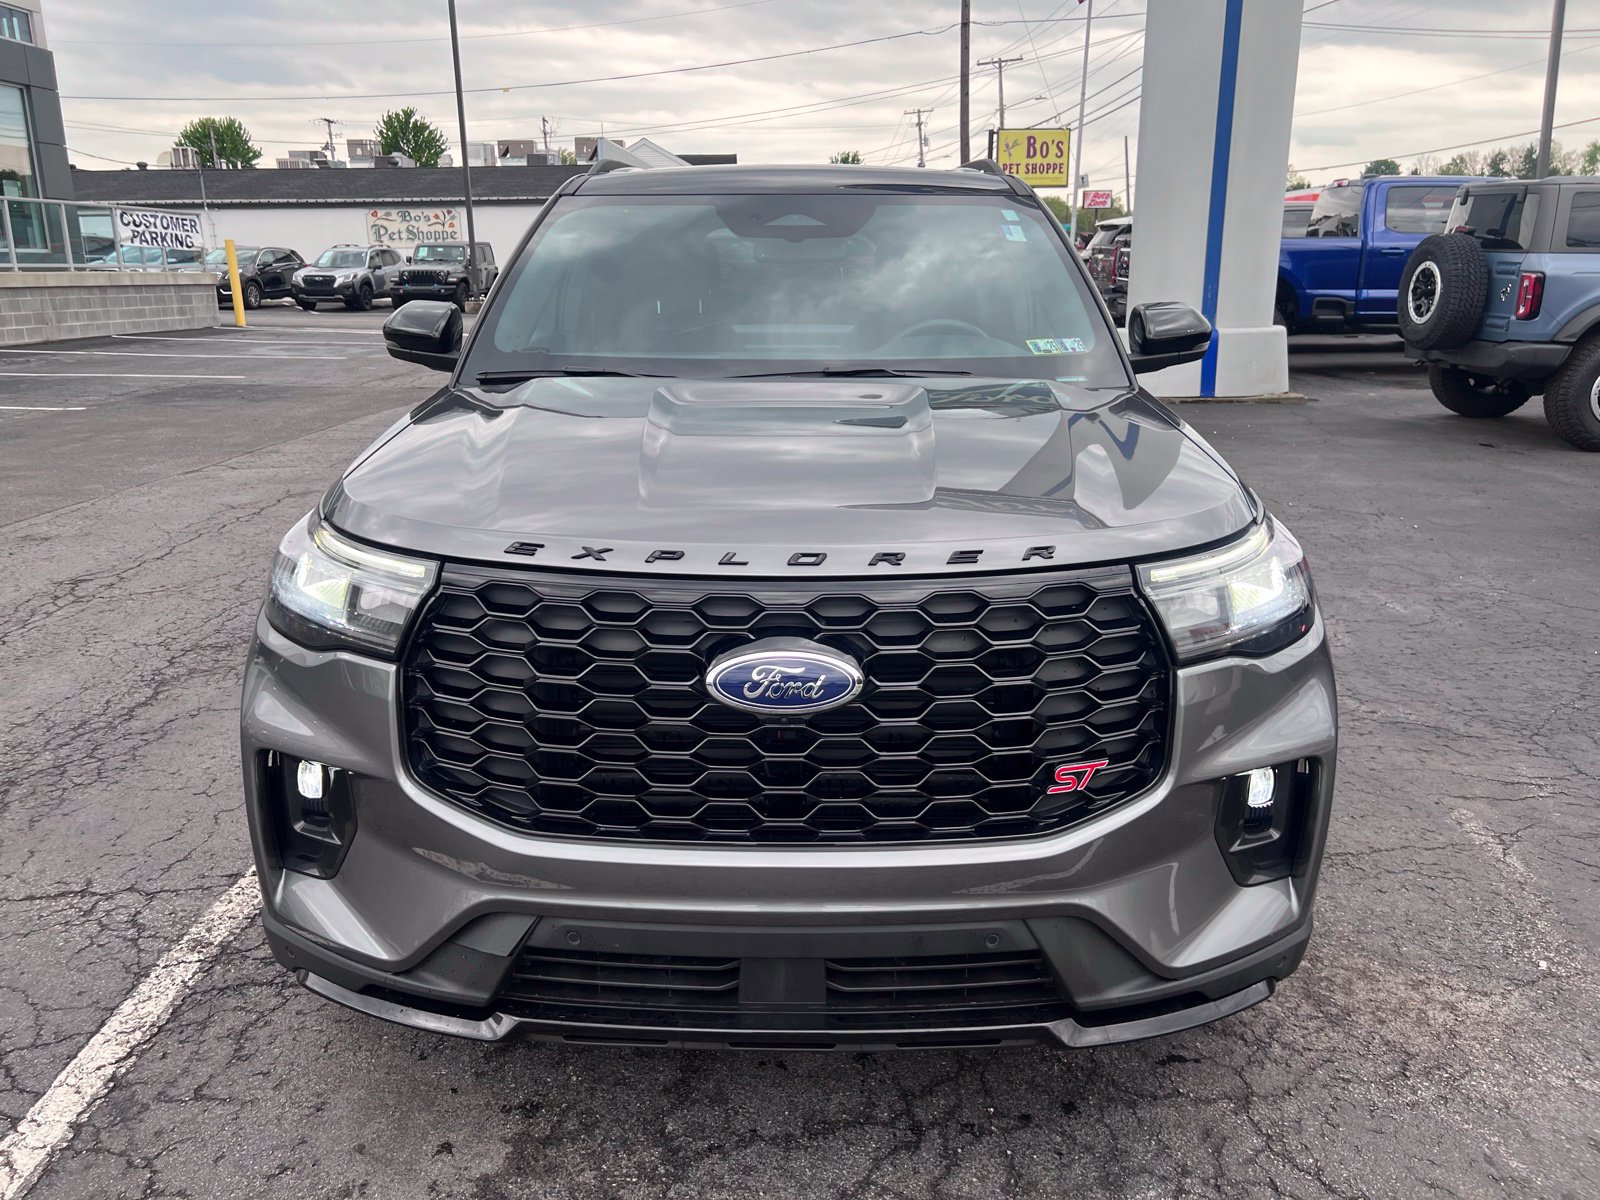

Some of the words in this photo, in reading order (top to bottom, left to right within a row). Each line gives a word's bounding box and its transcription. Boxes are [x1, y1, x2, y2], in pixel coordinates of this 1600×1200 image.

[1002, 163, 1021, 174] PET
[1025, 163, 1064, 174] SHOPPE
[120, 211, 199, 234] CUSTOMER
[397, 210, 431, 222] Bo's
[131, 230, 195, 249] PARKING
[371, 224, 404, 243] Pet
[406, 224, 458, 242] Shoppe
[504, 541, 1056, 566] EXPLORER
[743, 665, 826, 699] Ford
[1047, 760, 1109, 794] ST
